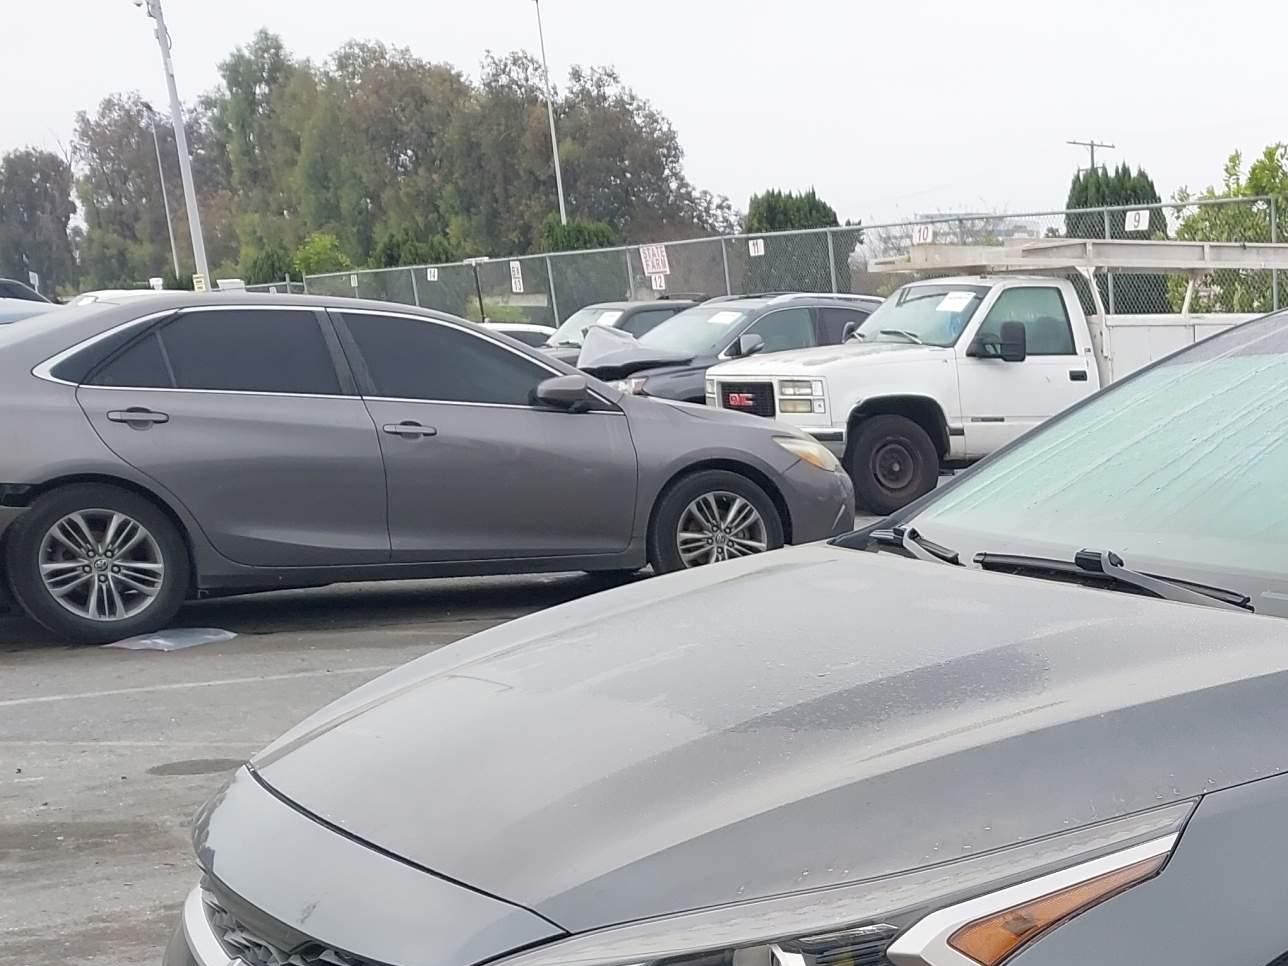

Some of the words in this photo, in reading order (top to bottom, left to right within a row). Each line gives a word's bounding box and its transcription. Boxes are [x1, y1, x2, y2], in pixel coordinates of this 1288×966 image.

[1133, 212, 1141, 228] 9
[918, 226, 929, 242] 10
[642, 246, 666, 260] STATE
[646, 257, 668, 271] FARM
[653, 274, 664, 288] 12
